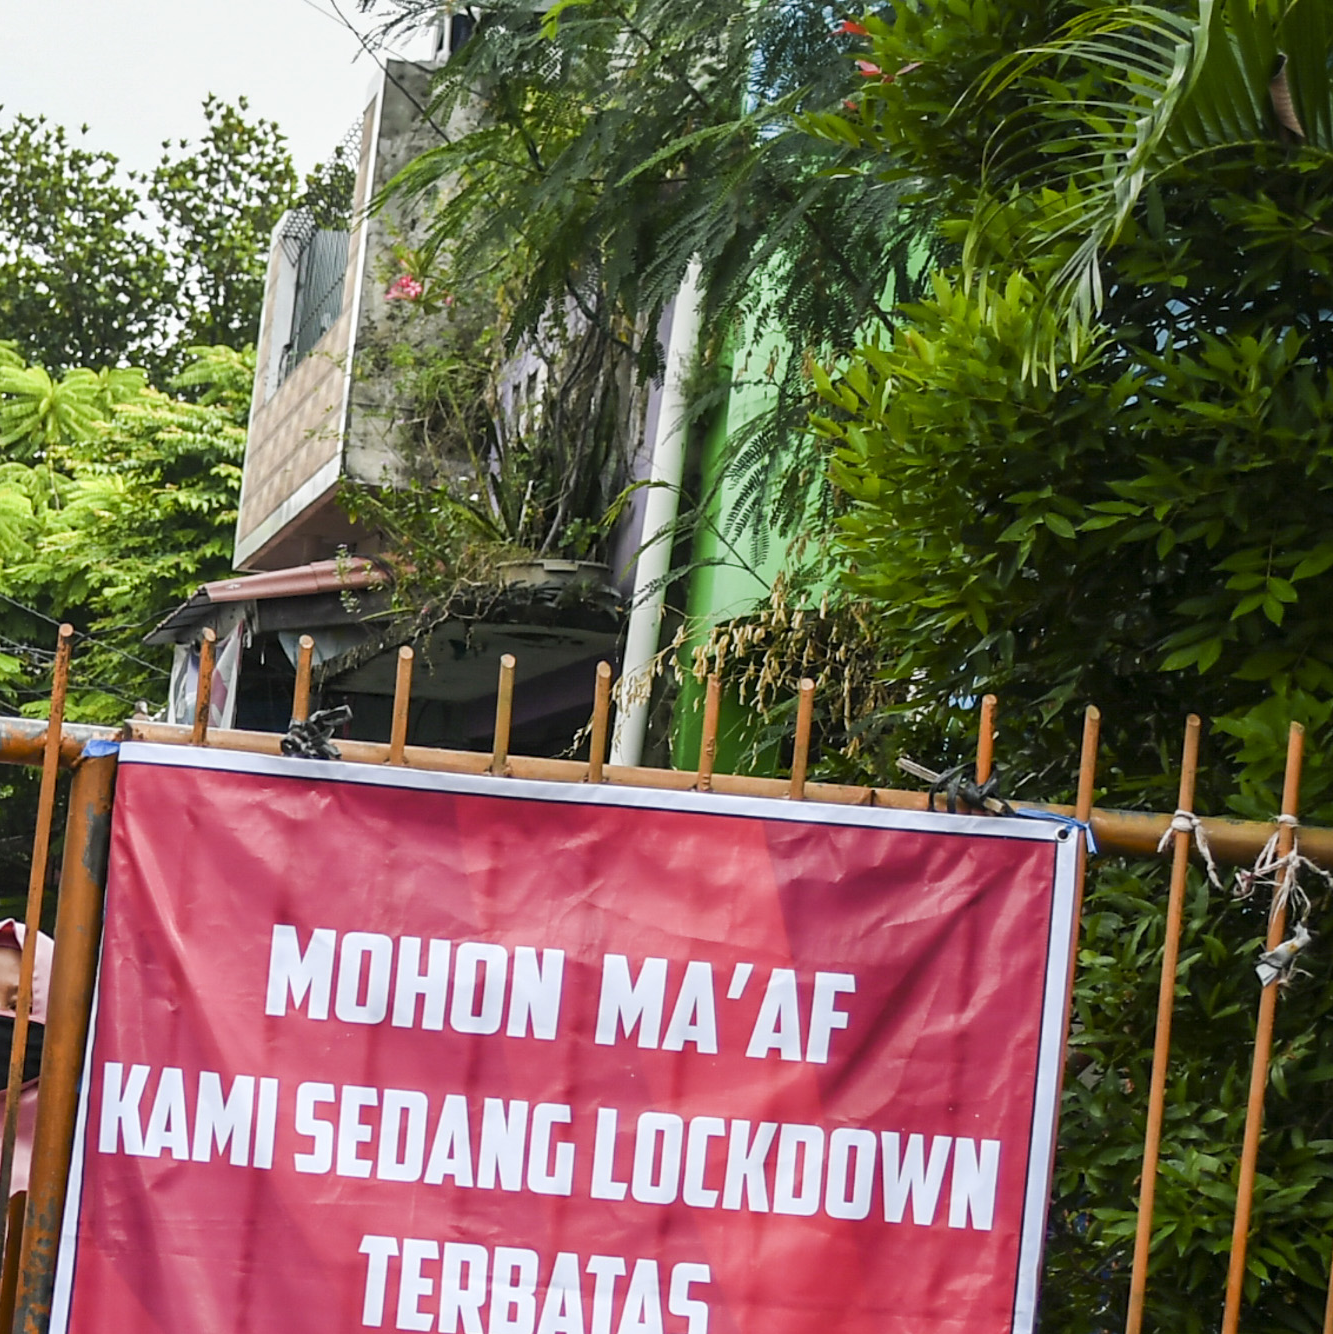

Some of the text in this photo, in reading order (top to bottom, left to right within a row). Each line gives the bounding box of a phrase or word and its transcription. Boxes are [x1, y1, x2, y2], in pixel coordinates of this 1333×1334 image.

[265, 924, 856, 1064] MOHON MA'AF
[98, 1061, 1001, 1230] KAMI SEDANG LOCKDOWN
